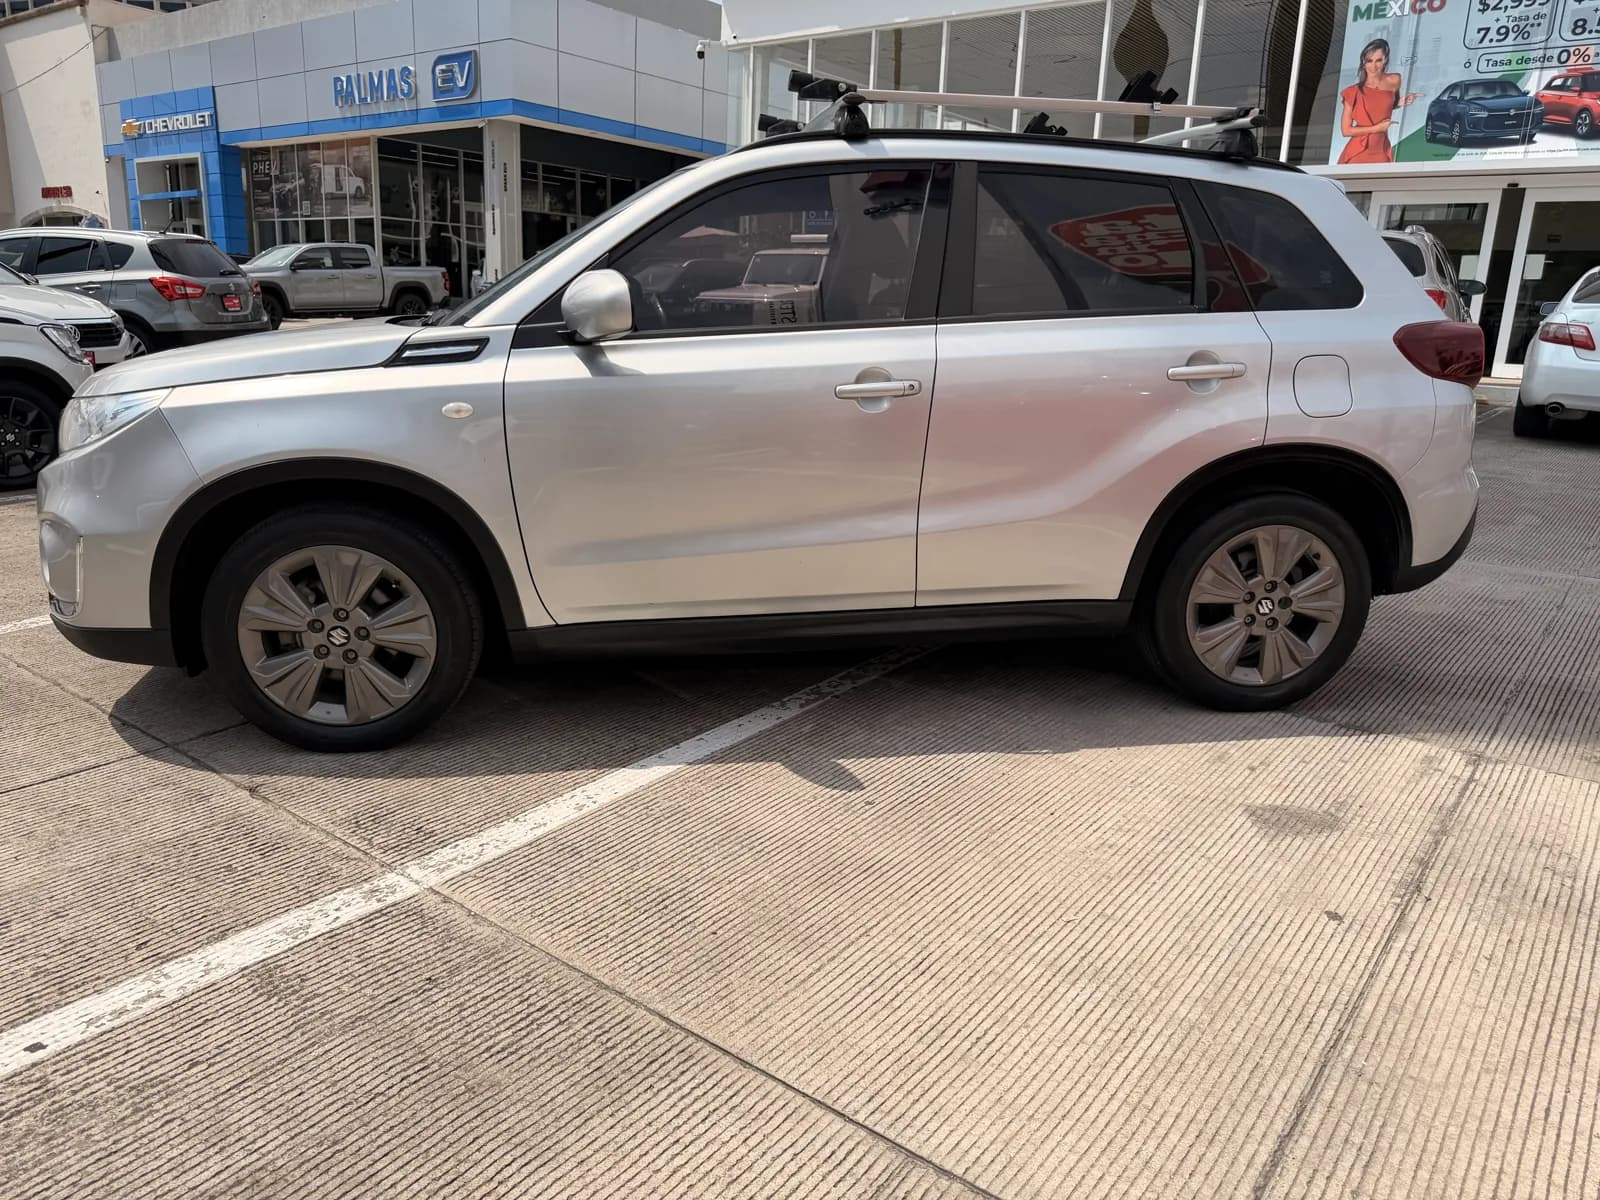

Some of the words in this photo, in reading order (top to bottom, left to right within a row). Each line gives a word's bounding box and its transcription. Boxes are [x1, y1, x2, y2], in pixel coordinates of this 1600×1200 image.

[1506, 15, 1530, 23] Tasa
[1533, 11, 1547, 21] de
[1485, 58, 1512, 68] Tasa
[1516, 53, 1555, 65] desde
[1557, 47, 1591, 65] 0%
[333, 65, 415, 108] PALMAS
[435, 60, 472, 90] EV
[145, 111, 213, 135] CHEVROLET
